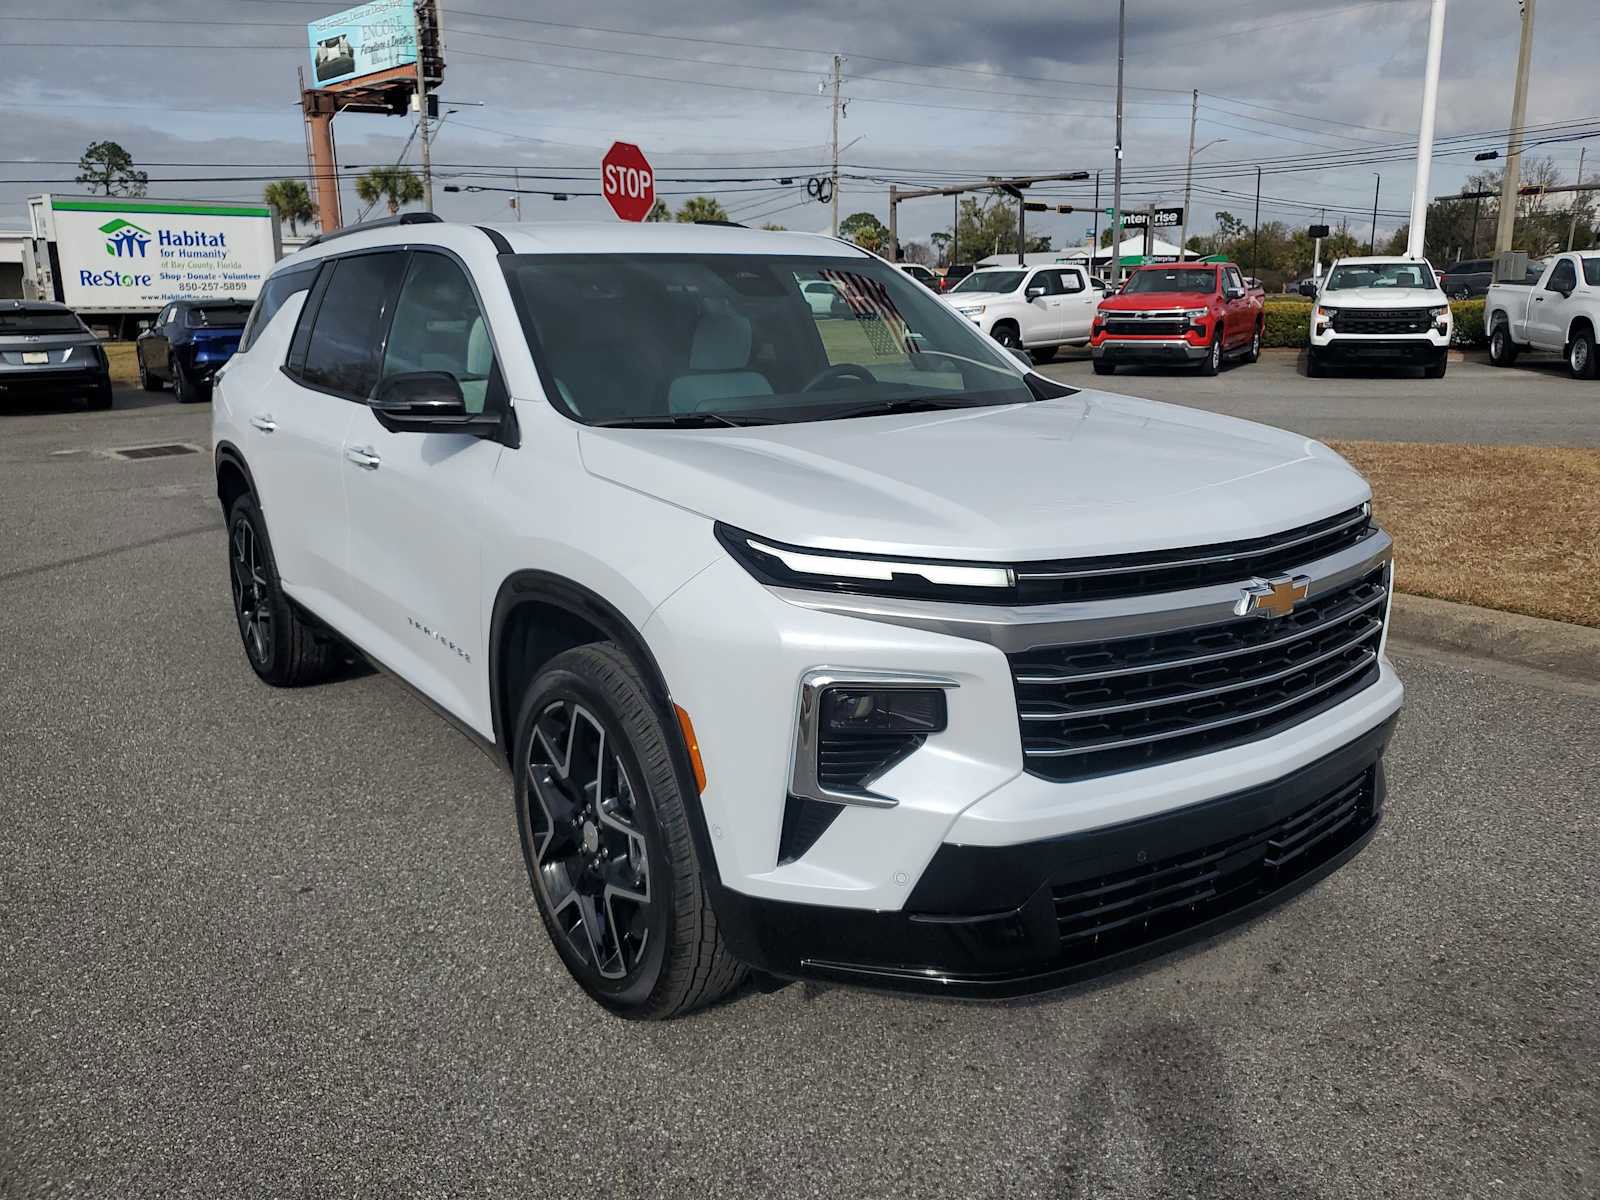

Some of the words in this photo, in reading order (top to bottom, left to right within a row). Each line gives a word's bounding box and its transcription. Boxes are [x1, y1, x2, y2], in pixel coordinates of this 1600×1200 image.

[605, 164, 651, 199] STOP
[158, 230, 226, 247] Habitat
[160, 249, 175, 257] for
[179, 249, 227, 260] Humanity
[80, 270, 152, 287] ReStore
[160, 272, 181, 281] Shop
[187, 272, 216, 280] Donate
[222, 272, 261, 280] Volunteer
[179, 282, 247, 291] 850-257-5859
